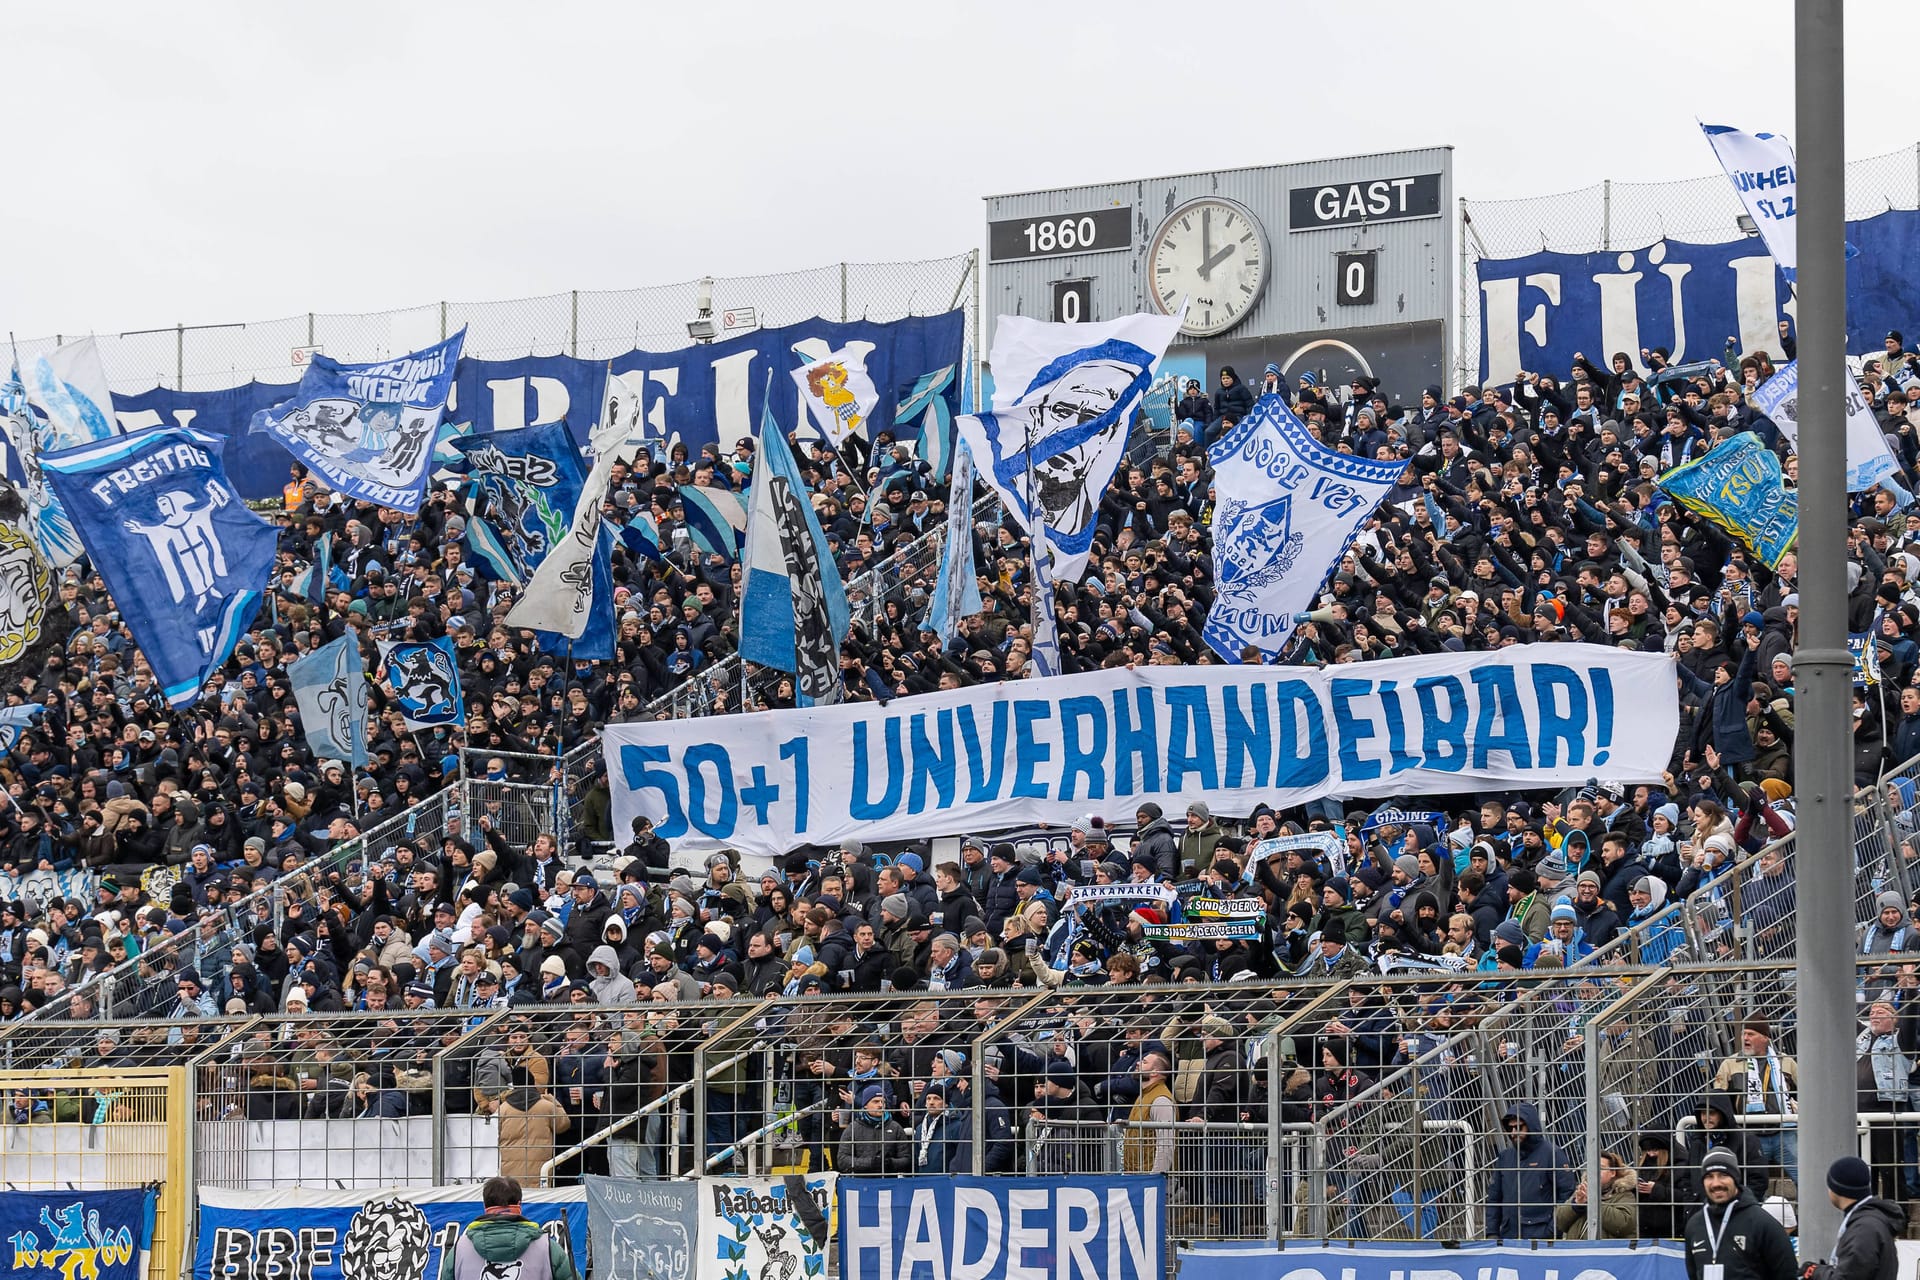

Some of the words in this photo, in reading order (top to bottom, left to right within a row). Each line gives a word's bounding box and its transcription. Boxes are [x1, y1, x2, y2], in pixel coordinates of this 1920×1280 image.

[1314, 178, 1415, 220] GAST
[1024, 216, 1097, 253] 1860
[1345, 261, 1365, 298] 0
[1062, 291, 1080, 323] 0
[91, 445, 211, 506] FREITAG
[1695, 480, 1716, 500] für
[620, 736, 809, 840] 50+1
[849, 663, 1615, 820] UNVERHANDELBAR!
[1376, 812, 1430, 824] GIASING
[1073, 885, 1162, 899] SARKANAKEN
[1196, 899, 1218, 911] SIND
[1231, 899, 1250, 911] DER
[1144, 927, 1163, 937] WIR
[1164, 926, 1186, 937] SIND
[1199, 925, 1217, 935] DER
[1218, 924, 1256, 936] VEREIN
[604, 1184, 632, 1203] Blue
[638, 1188, 683, 1212] Vikings
[8, 1230, 39, 1270] 18
[102, 1225, 133, 1267] 60
[846, 1187, 1158, 1280] HADERN
